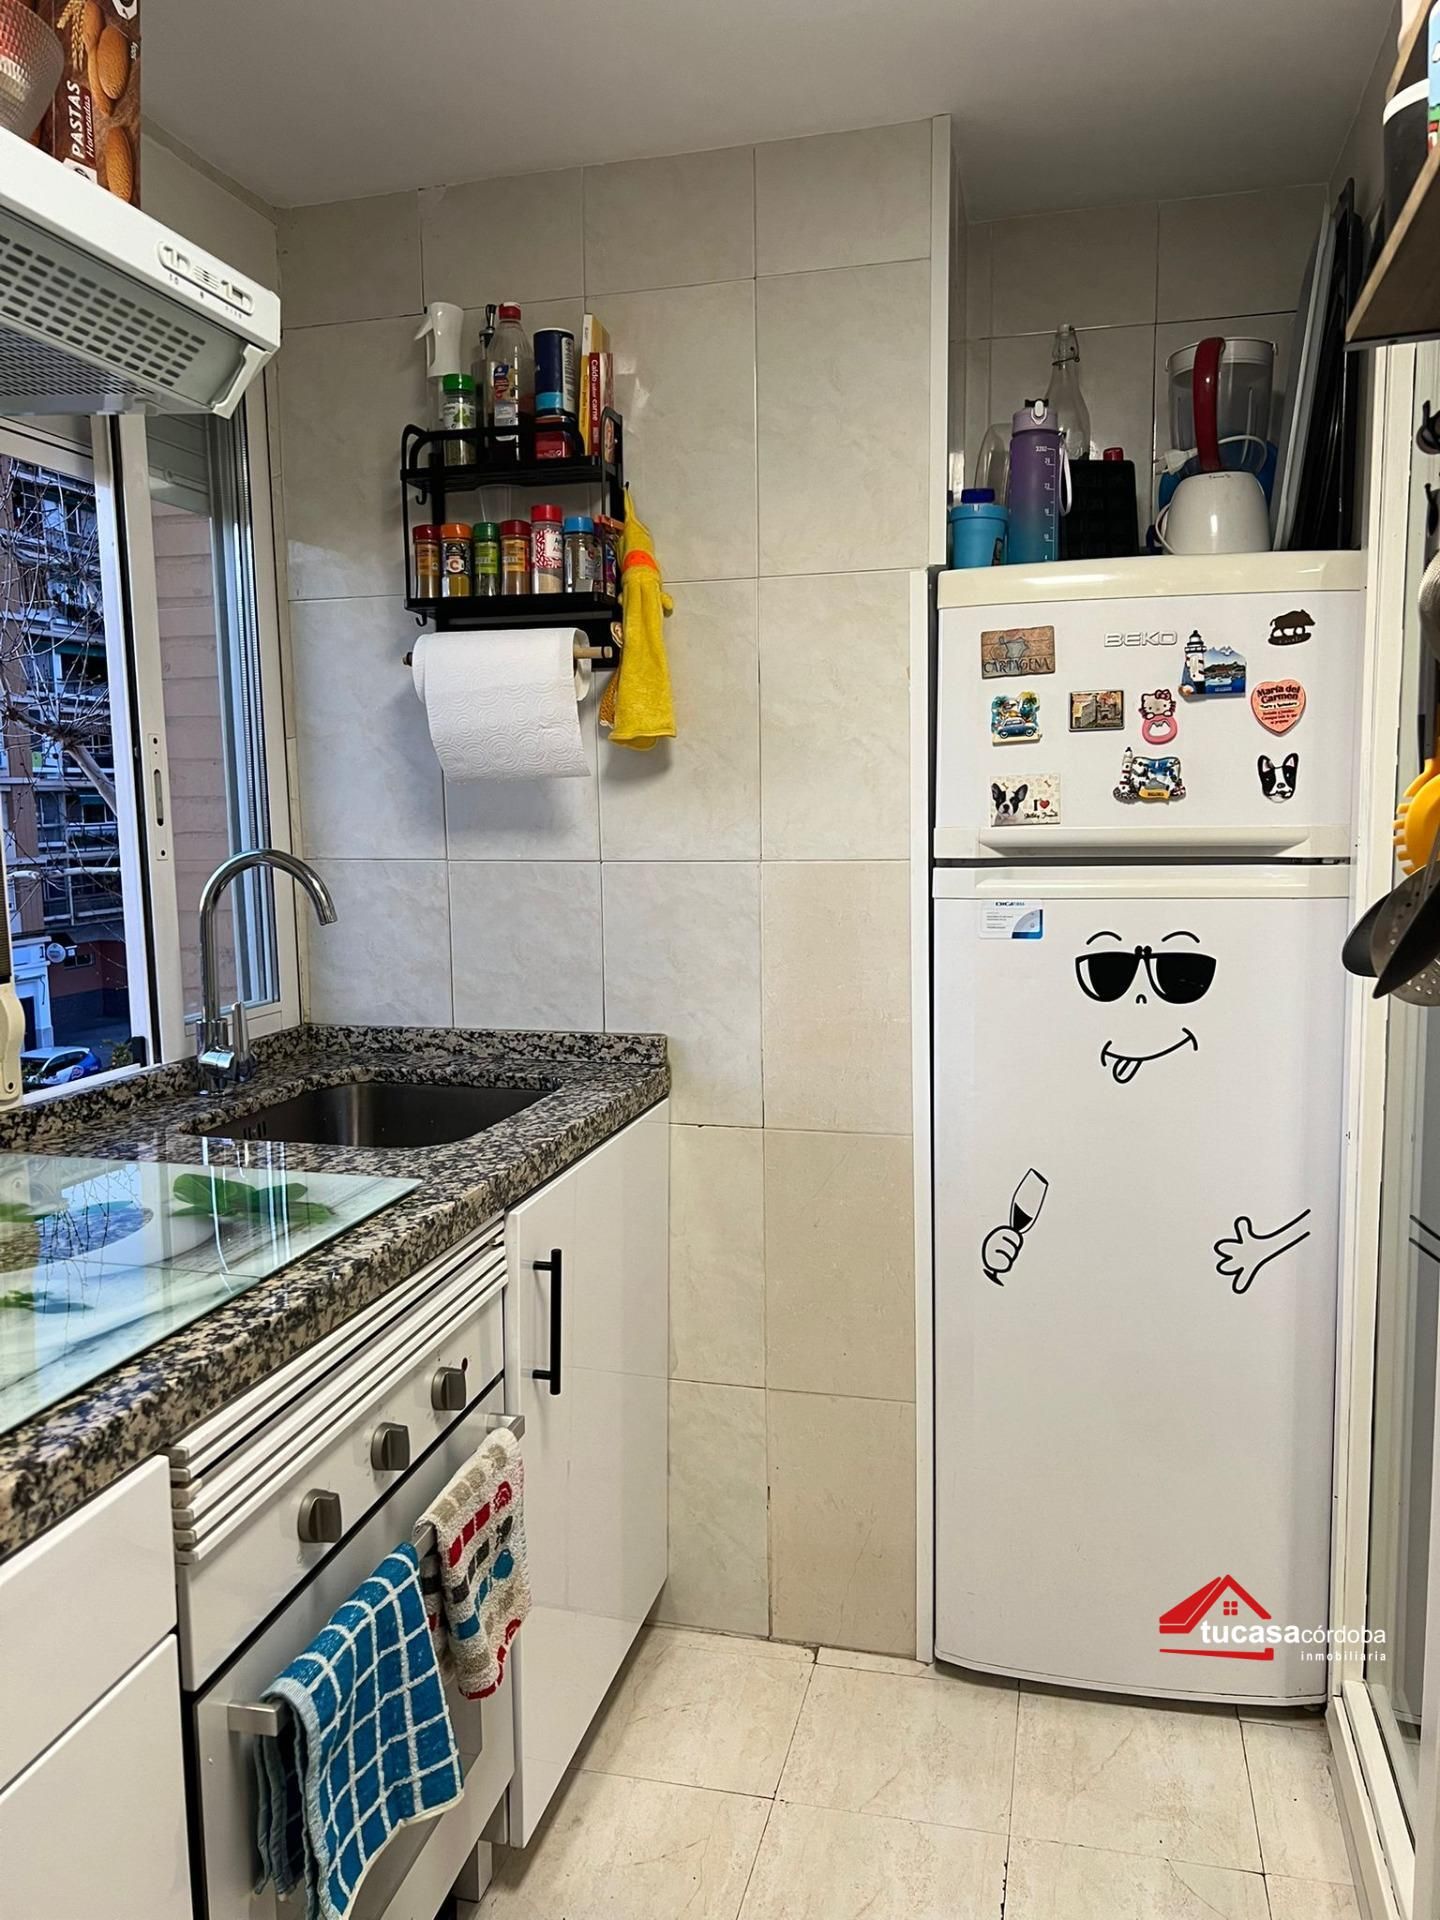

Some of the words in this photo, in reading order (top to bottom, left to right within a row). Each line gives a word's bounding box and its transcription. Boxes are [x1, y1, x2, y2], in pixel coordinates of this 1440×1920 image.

[66, 80, 85, 159] PASTAS
[83, 95, 95, 158] Horneadas
[591, 360, 599, 382] Caldo
[1103, 631, 1178, 647] BEKO
[983, 656, 1051, 673] CARTAGENA
[1256, 685, 1284, 698] María
[1285, 685, 1300, 694] del
[1261, 693, 1298, 704] Carmen
[1033, 799, 1038, 811] I
